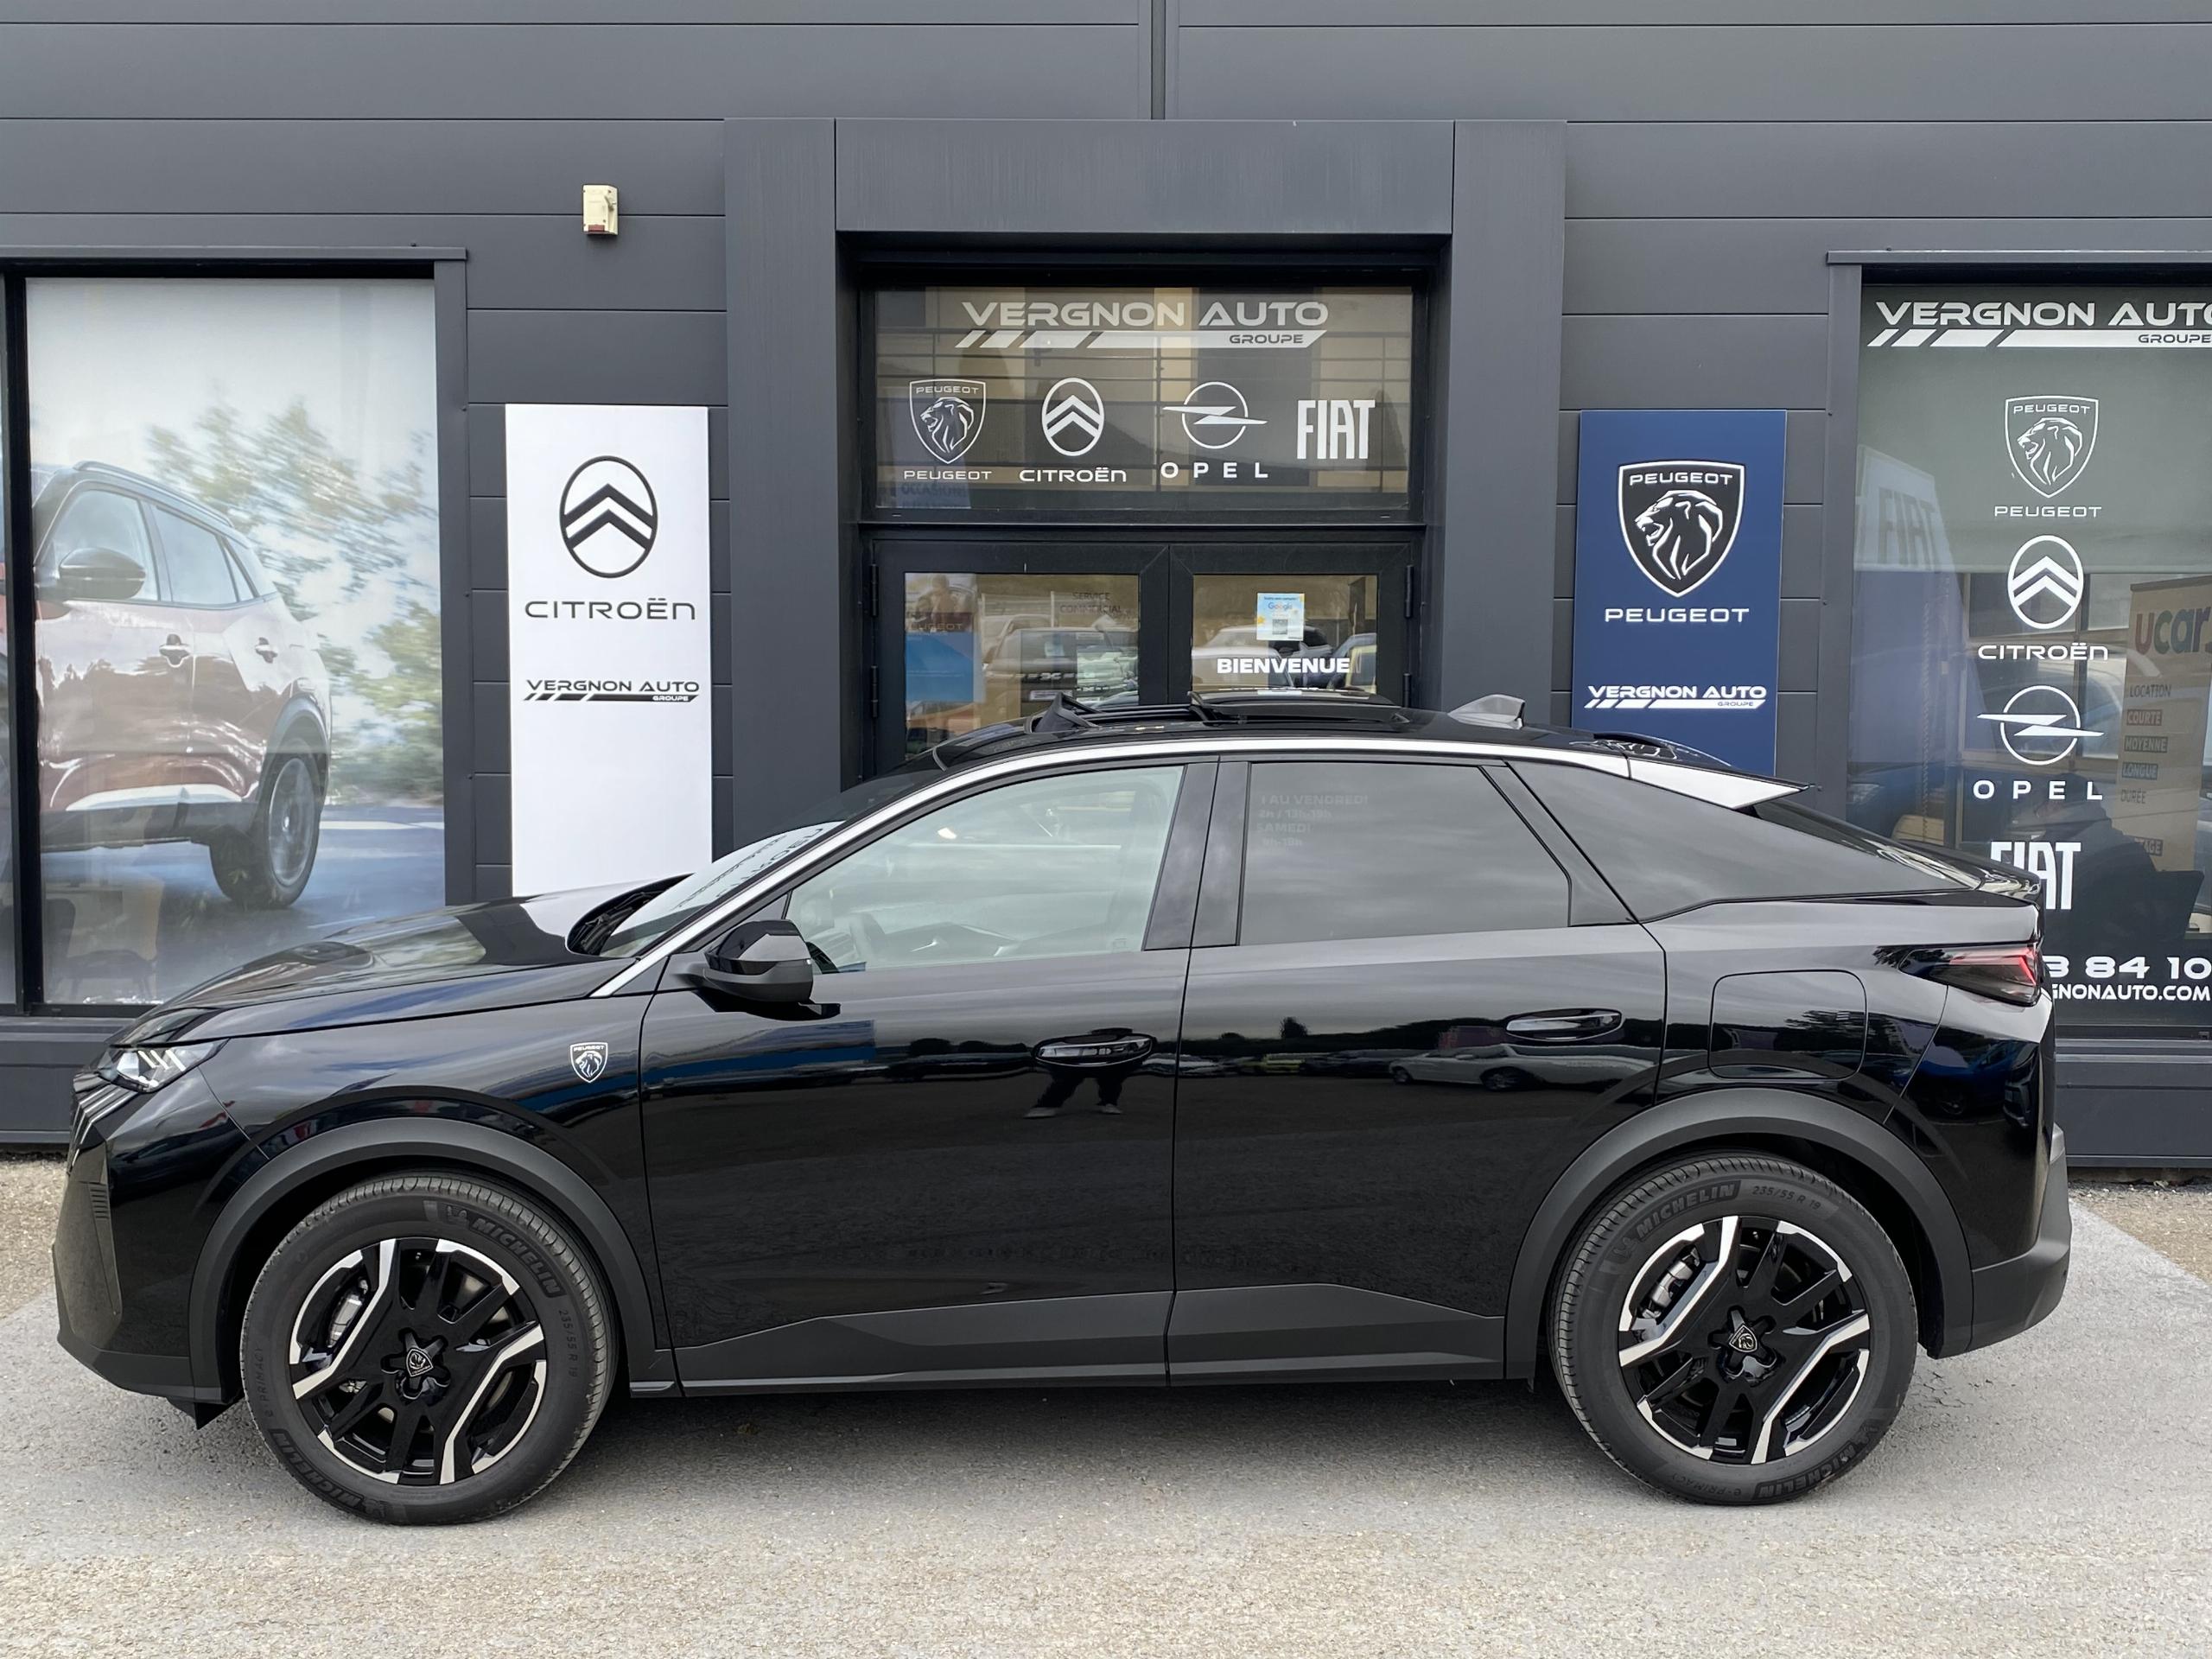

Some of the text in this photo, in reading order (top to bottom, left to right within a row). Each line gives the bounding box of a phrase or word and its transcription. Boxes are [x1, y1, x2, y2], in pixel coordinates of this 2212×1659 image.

[962, 302, 1329, 327] VERGNON AUTO
[1876, 302, 2212, 327] VERGNON AUT
[1229, 334, 1304, 344] GROUPE
[2138, 334, 2212, 344] GROUPE
[916, 385, 979, 395] PEUGEOT
[2013, 404, 2091, 415] PEUGEOT
[1297, 399, 1376, 460] FIAT
[904, 470, 993, 480] PEUGEOT
[1160, 461, 1268, 479] OPEL
[1630, 472, 1733, 486] PEUGEOT
[1994, 505, 2102, 518] PEUGEOT
[1605, 607, 1750, 623] PEUGEOT
[2135, 607, 2212, 655] ucar
[1217, 658, 1351, 674] BIENVENUE
[526, 679, 700, 693] VERGNON AUTO
[1588, 685, 1768, 699] VERGNON AUTO
[2129, 683, 2171, 698] LOCATION
[2127, 710, 2161, 725] COURTE
[2126, 737, 2167, 752] MOYENNE
[2122, 763, 2158, 779] LONGUE
[1973, 779, 2103, 801] OPEL
[2086, 956, 2151, 979] 84
[2166, 957, 2212, 980] 10
[1752, 1185, 1822, 1211] 235/55 R 19
[1637, 1184, 1736, 1239] MICHELIN
[472, 1217, 562, 1294] MICHELIN
[557, 1308, 577, 1352] 235/55
[568, 1366, 579, 1378] 19
[270, 1432, 362, 1508] MICHELIN
[1758, 1444, 1855, 1498] MICHELIN
